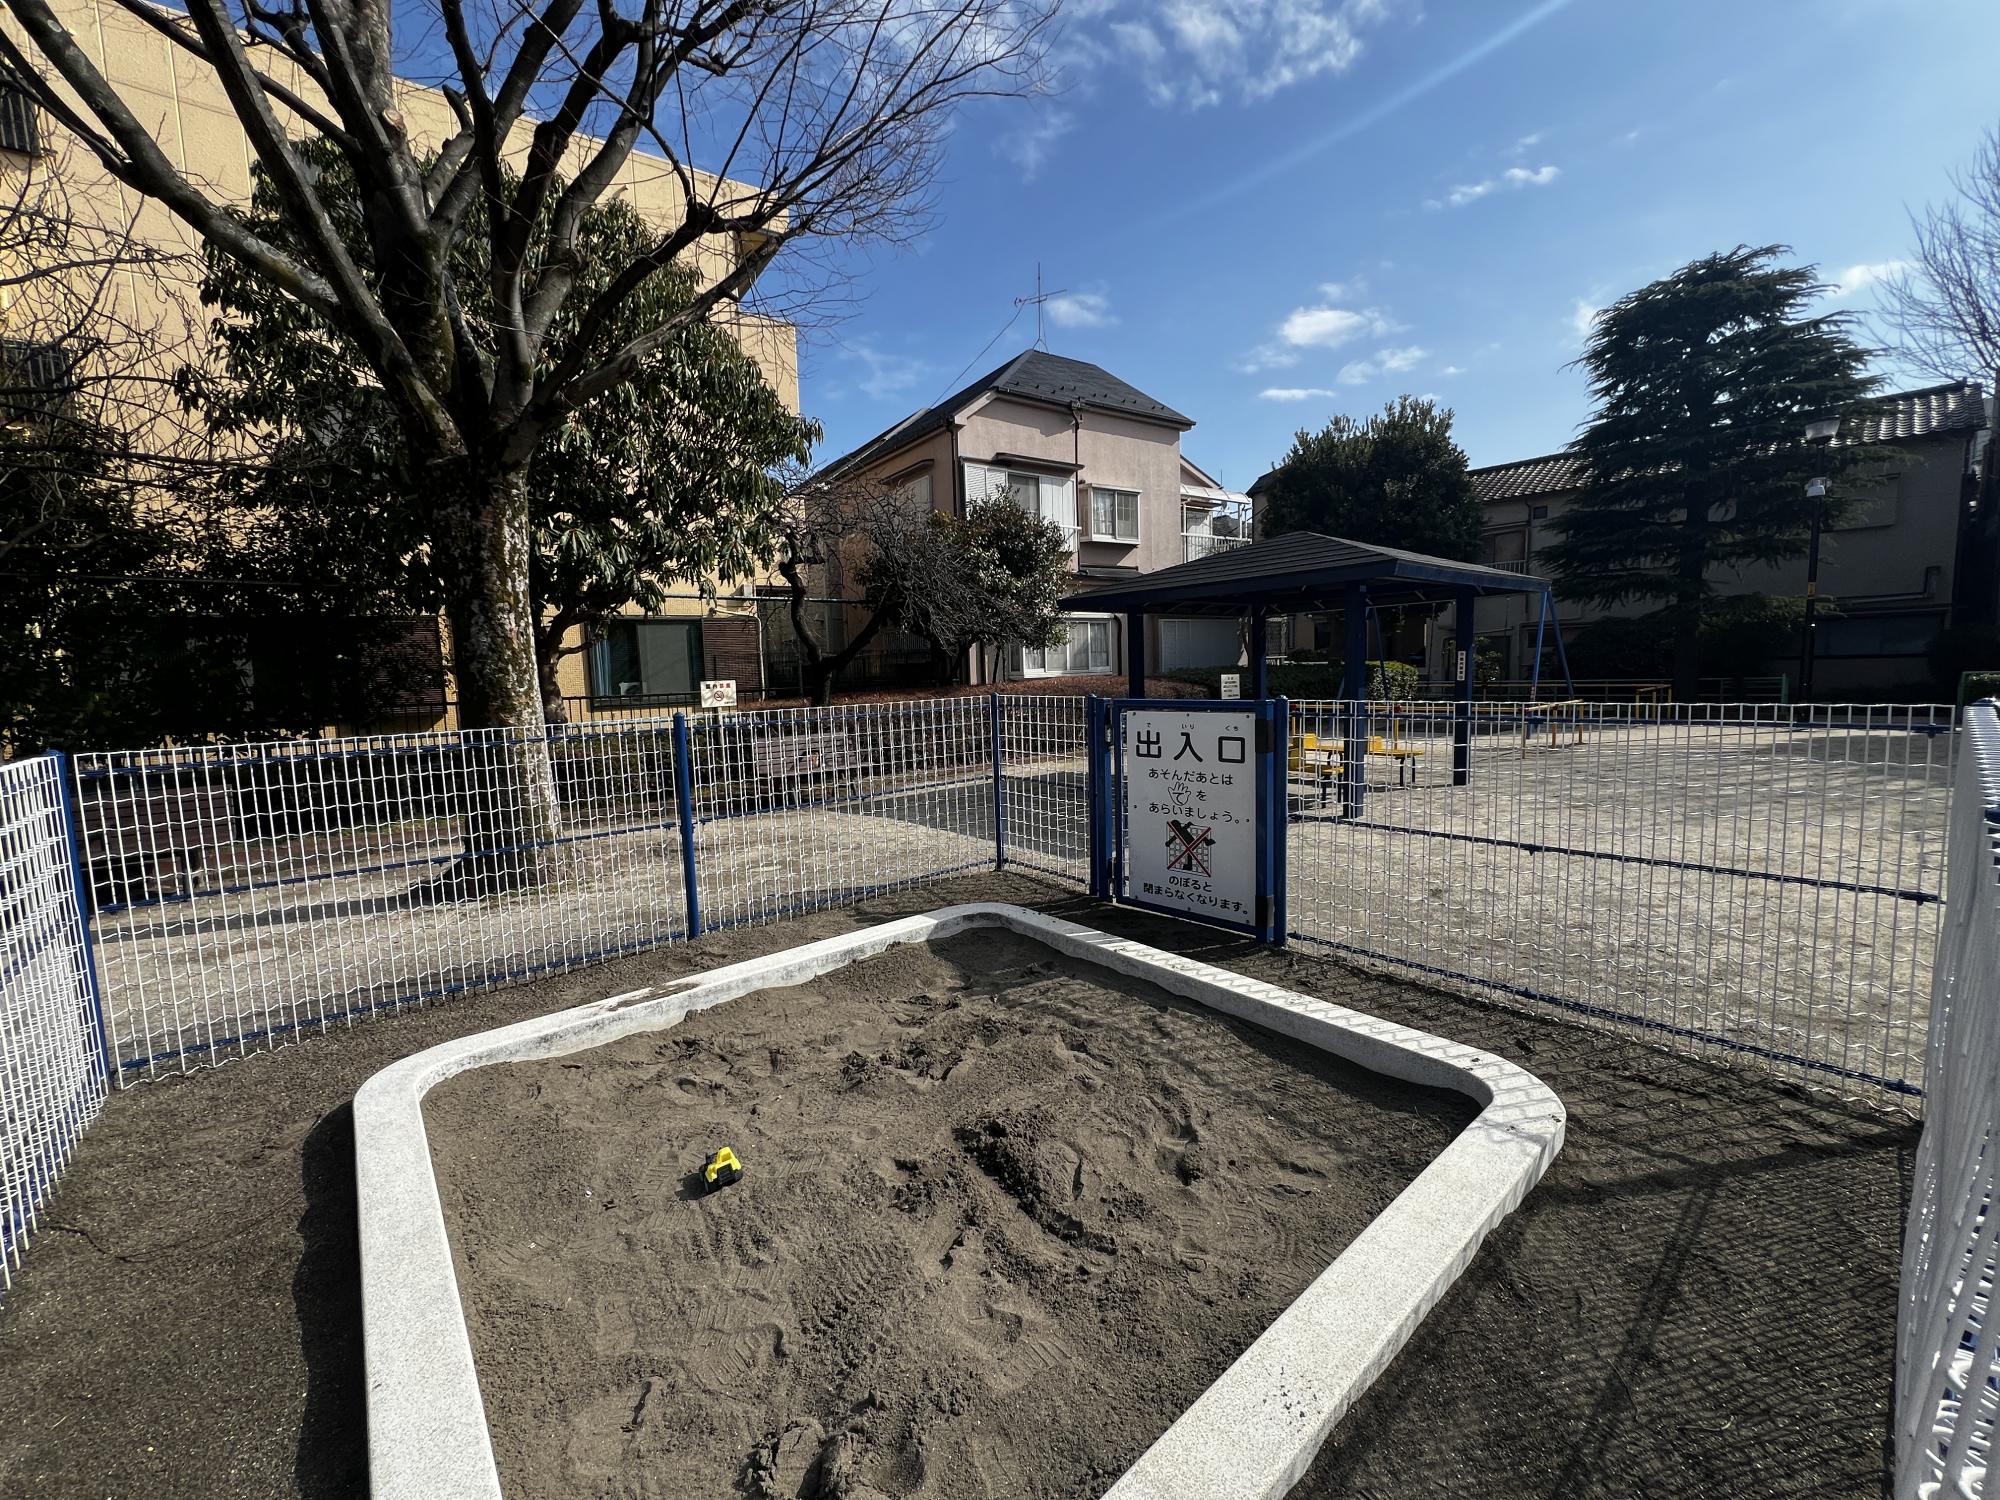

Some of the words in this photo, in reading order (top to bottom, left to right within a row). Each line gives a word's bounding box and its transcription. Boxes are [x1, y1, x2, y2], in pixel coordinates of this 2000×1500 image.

[1136, 730, 1245, 763] 出入口
[1148, 768, 1234, 786] あそんだあとは
[1149, 802, 1240, 824] あらいましょう。
[1168, 875, 1212, 892] のぼると
[1143, 882, 1248, 914] 閉まらなくなります。
